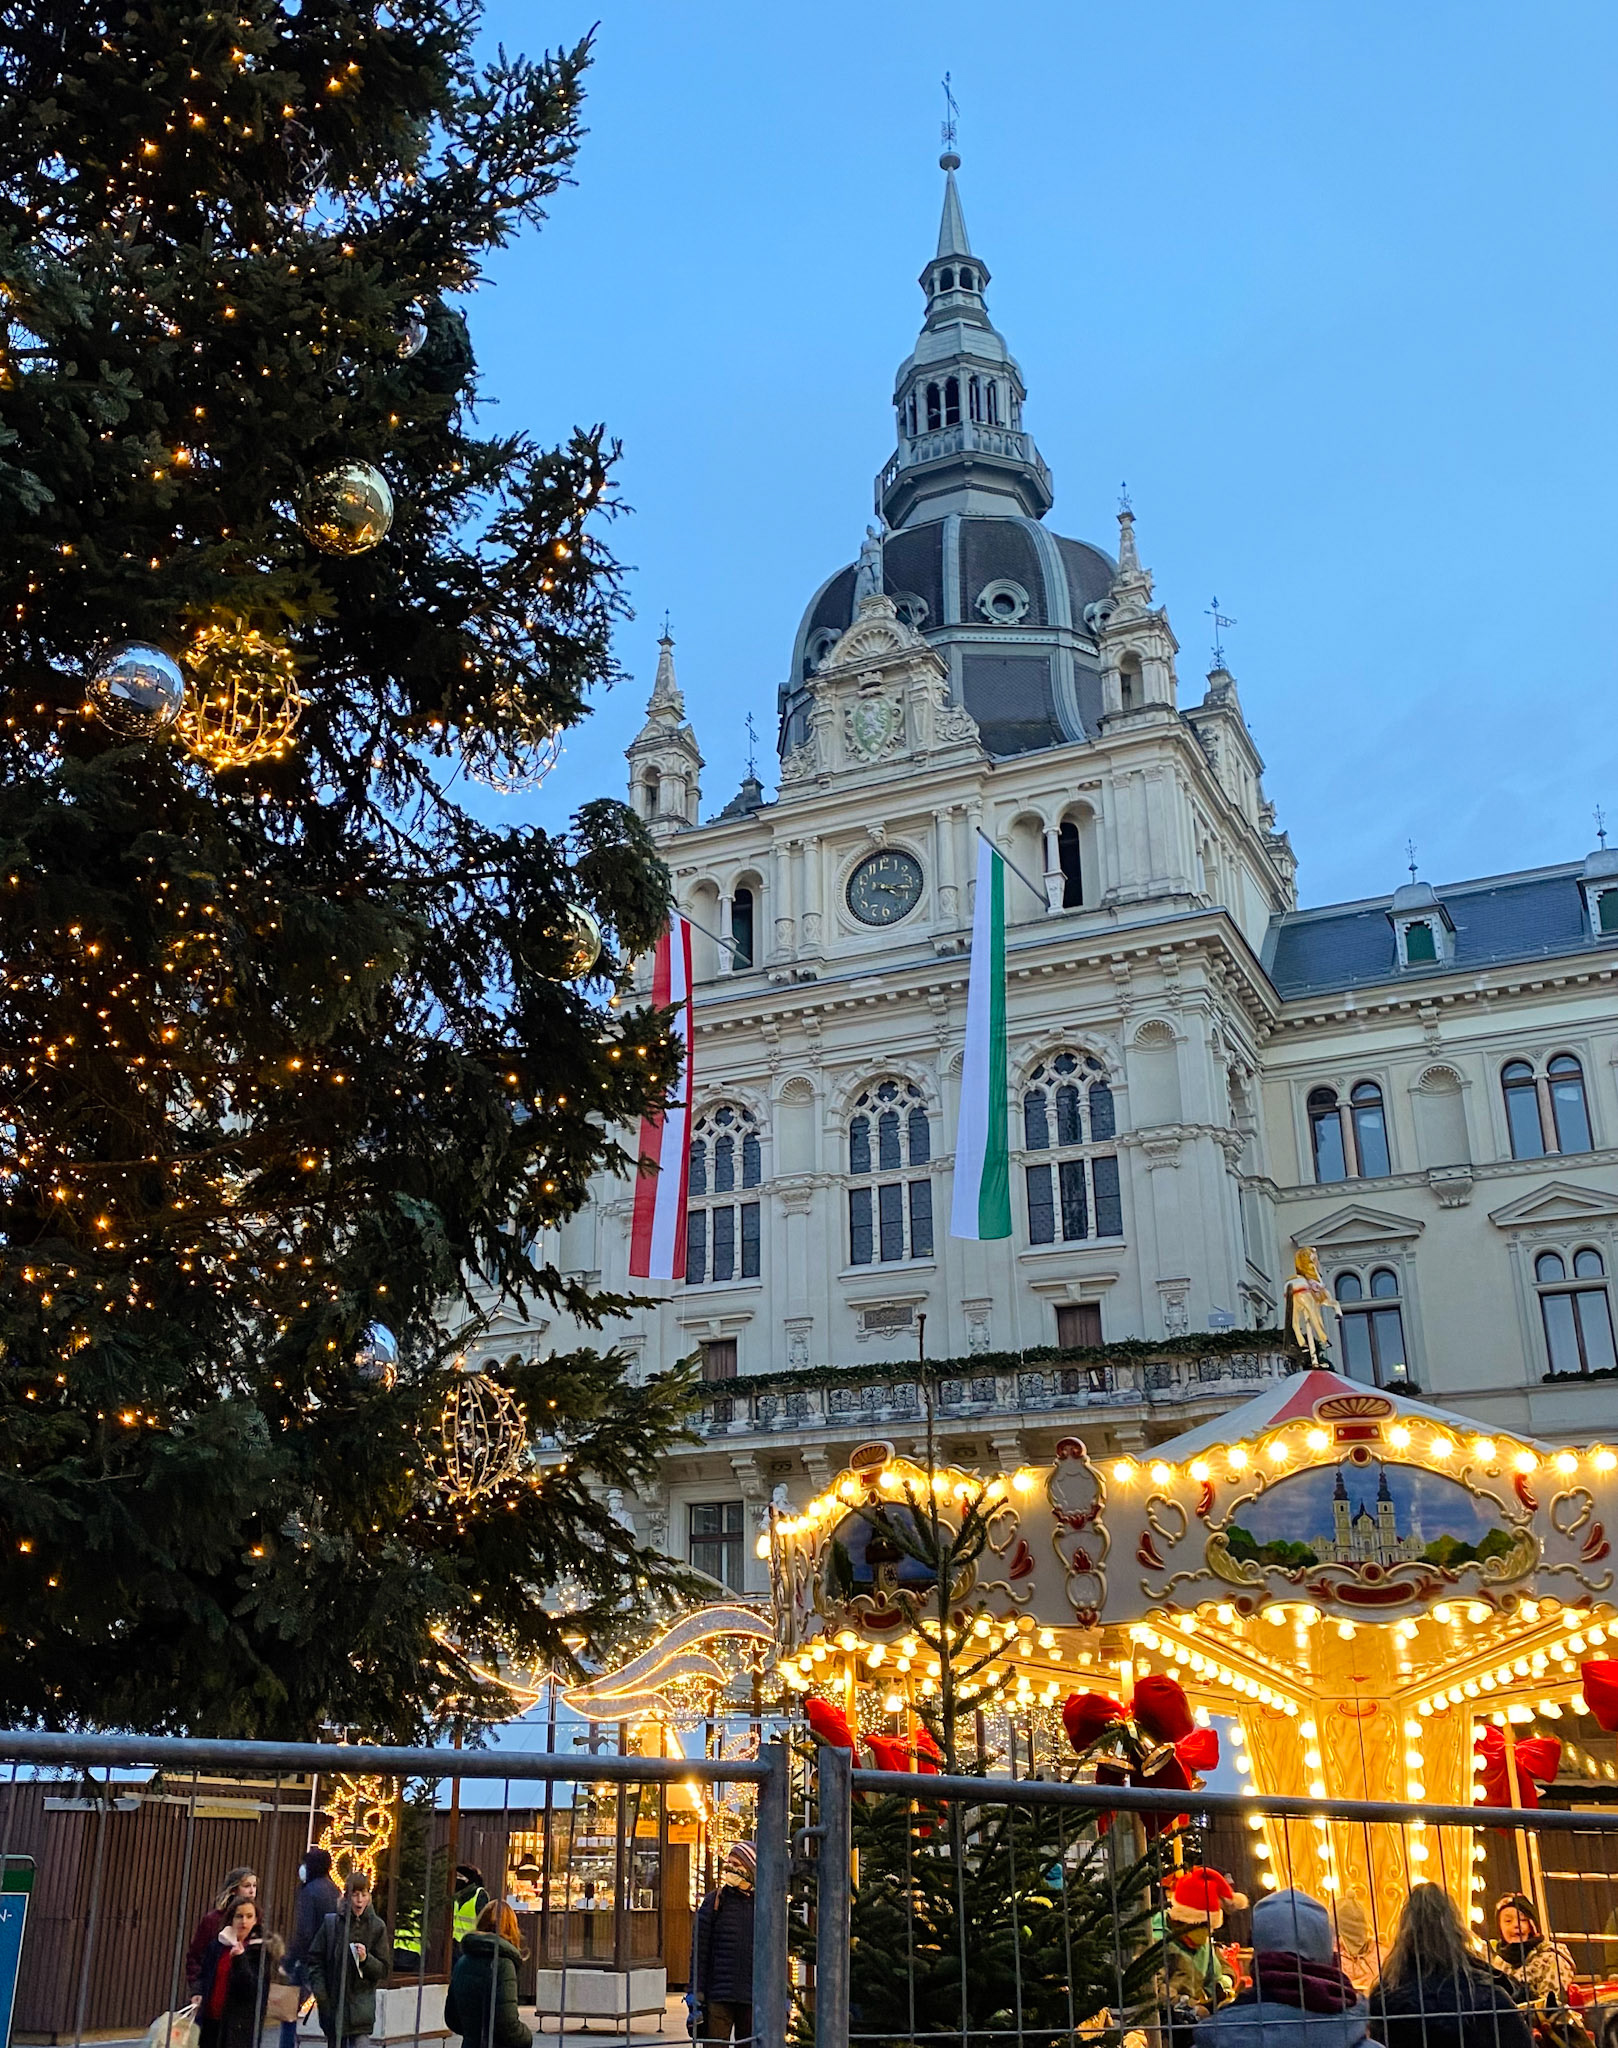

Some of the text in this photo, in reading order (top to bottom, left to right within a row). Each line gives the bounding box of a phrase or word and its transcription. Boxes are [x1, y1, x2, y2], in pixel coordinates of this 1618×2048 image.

[868, 863, 876, 876] 11
[879, 857, 889, 871] 12
[881, 903, 890, 917] 6
